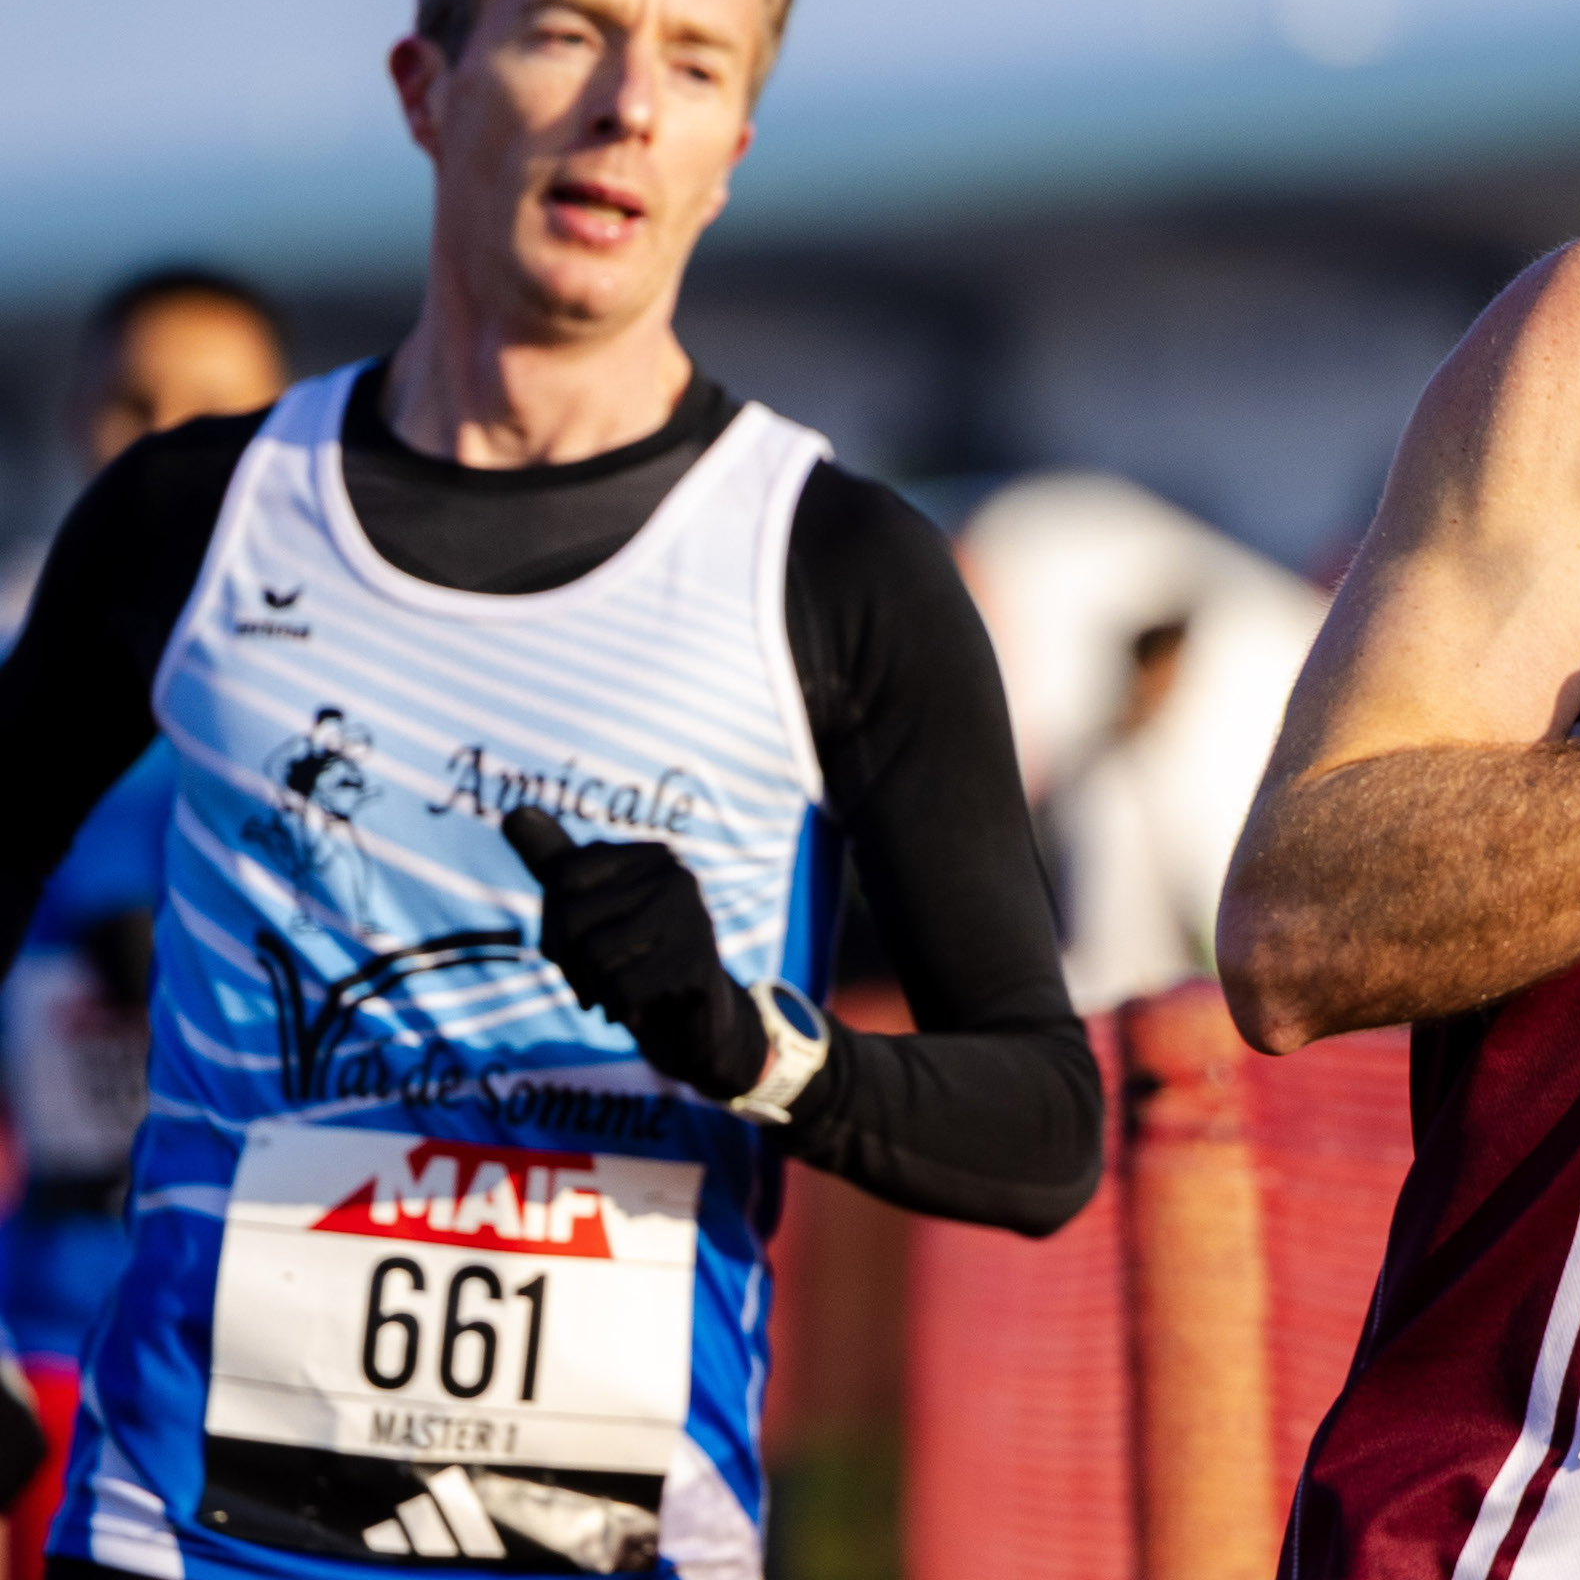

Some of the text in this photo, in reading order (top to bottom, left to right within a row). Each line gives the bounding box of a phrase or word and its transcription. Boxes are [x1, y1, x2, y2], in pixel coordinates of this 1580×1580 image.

[428, 745, 694, 835] Amicale
[402, 1040, 465, 1108] de
[370, 1154, 605, 1246] MAIF
[362, 1256, 549, 1403] 661
[369, 1410, 517, 1454] MASTER 1
